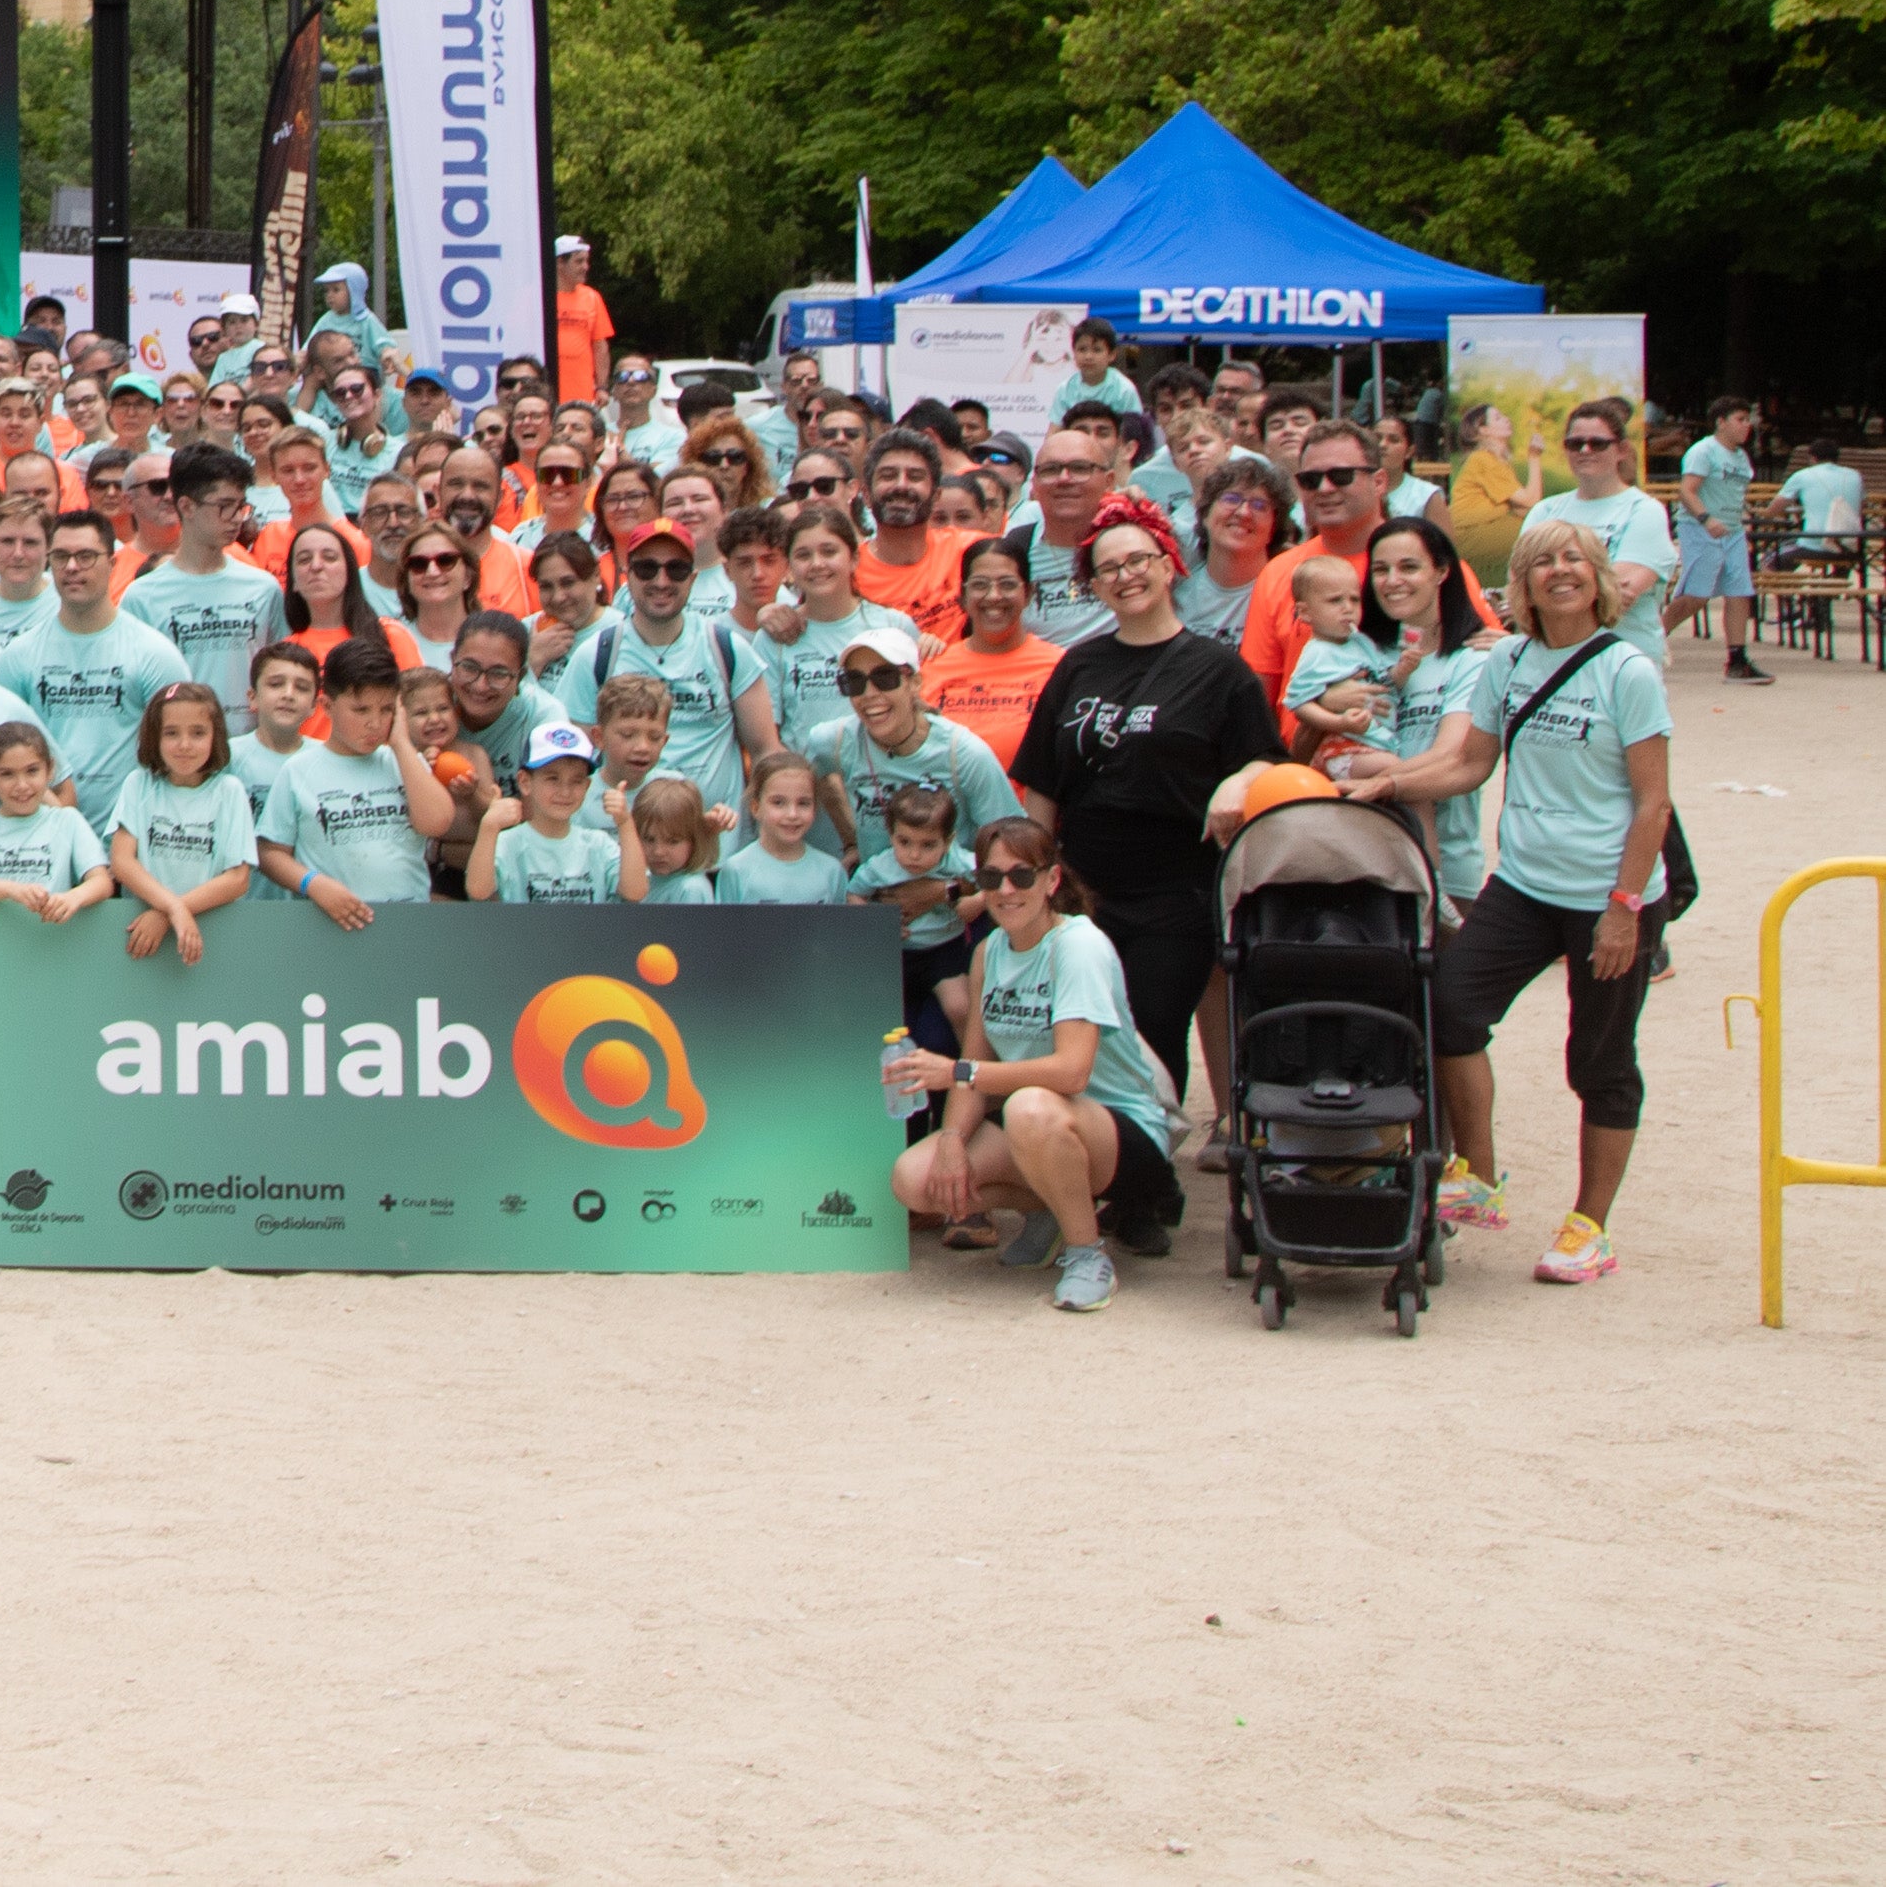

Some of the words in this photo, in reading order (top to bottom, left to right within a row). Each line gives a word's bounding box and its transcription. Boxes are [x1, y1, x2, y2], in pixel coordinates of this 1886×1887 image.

[1139, 286, 1384, 328] DECATHLON
[180, 620, 251, 635] CARRERA
[47, 685, 119, 698] CARRERA
[328, 804, 408, 823] CARRERA
[96, 993, 493, 1098] amiab
[173, 1176, 346, 1201] mediolanum
[173, 1202, 236, 1215] aproxima
[260, 1214, 346, 1232] mediolanum
